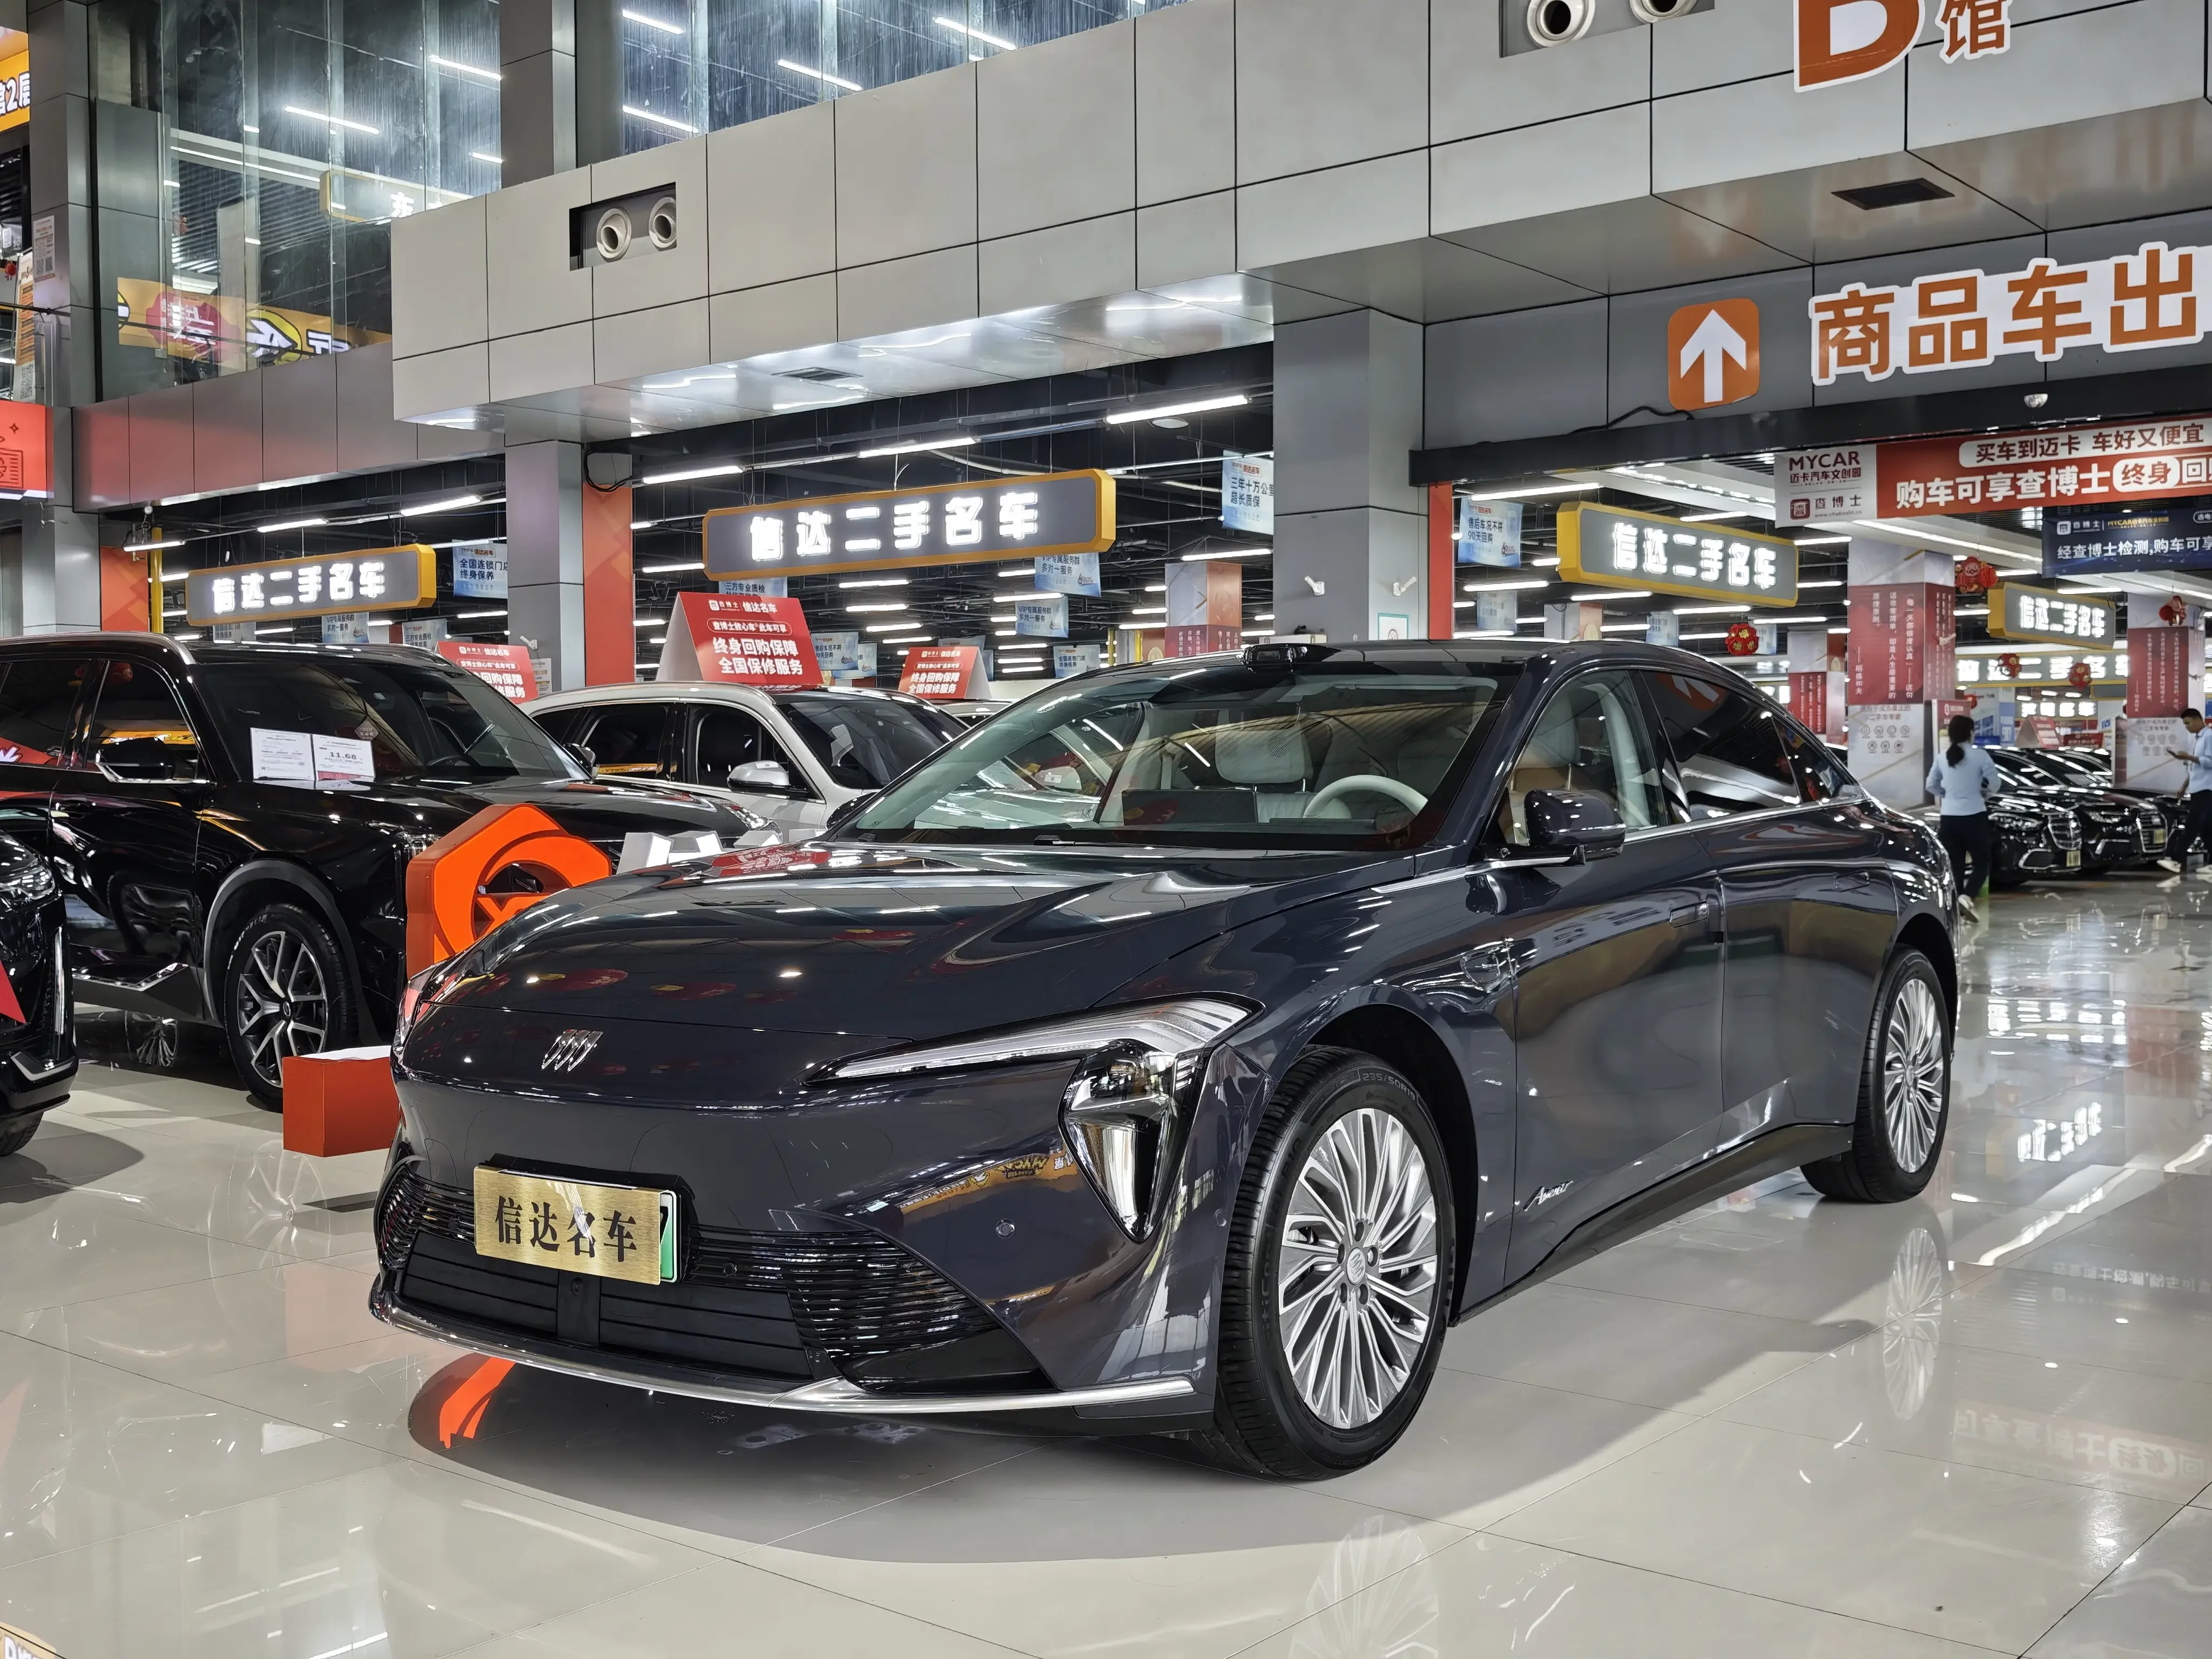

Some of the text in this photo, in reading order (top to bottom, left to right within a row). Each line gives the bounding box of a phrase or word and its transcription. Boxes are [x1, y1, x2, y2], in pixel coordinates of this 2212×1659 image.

[1975, 422, 2204, 463] 买车到迈卡 车好又便宜
[1789, 450, 1861, 471] MYCAR
[1790, 467, 1862, 484] 迈卡汽车文创园
[1230, 491, 1261, 508] 超长质保
[1815, 494, 1862, 510] 查博士
[749, 490, 1039, 562] 信达二手名车
[1612, 521, 1778, 590] 信达二手名车
[460, 569, 495, 581] 终身保养
[212, 561, 386, 615] 信达二手名车
[725, 582, 766, 593] 三方专业质检
[743, 601, 778, 614] 信达名车
[2019, 595, 2107, 639] 信达二手名车
[712, 636, 799, 657] 终身回购保障
[718, 656, 804, 676] 全国保修服务
[909, 672, 961, 684] 终身回购保障
[908, 683, 957, 694] 全国保修服务
[329, 751, 358, 760] 11.68
[1362, 1071, 1416, 1102] 235/50R19
[1522, 1179, 1574, 1212] Avenir
[495, 1195, 638, 1263] 信达名车
